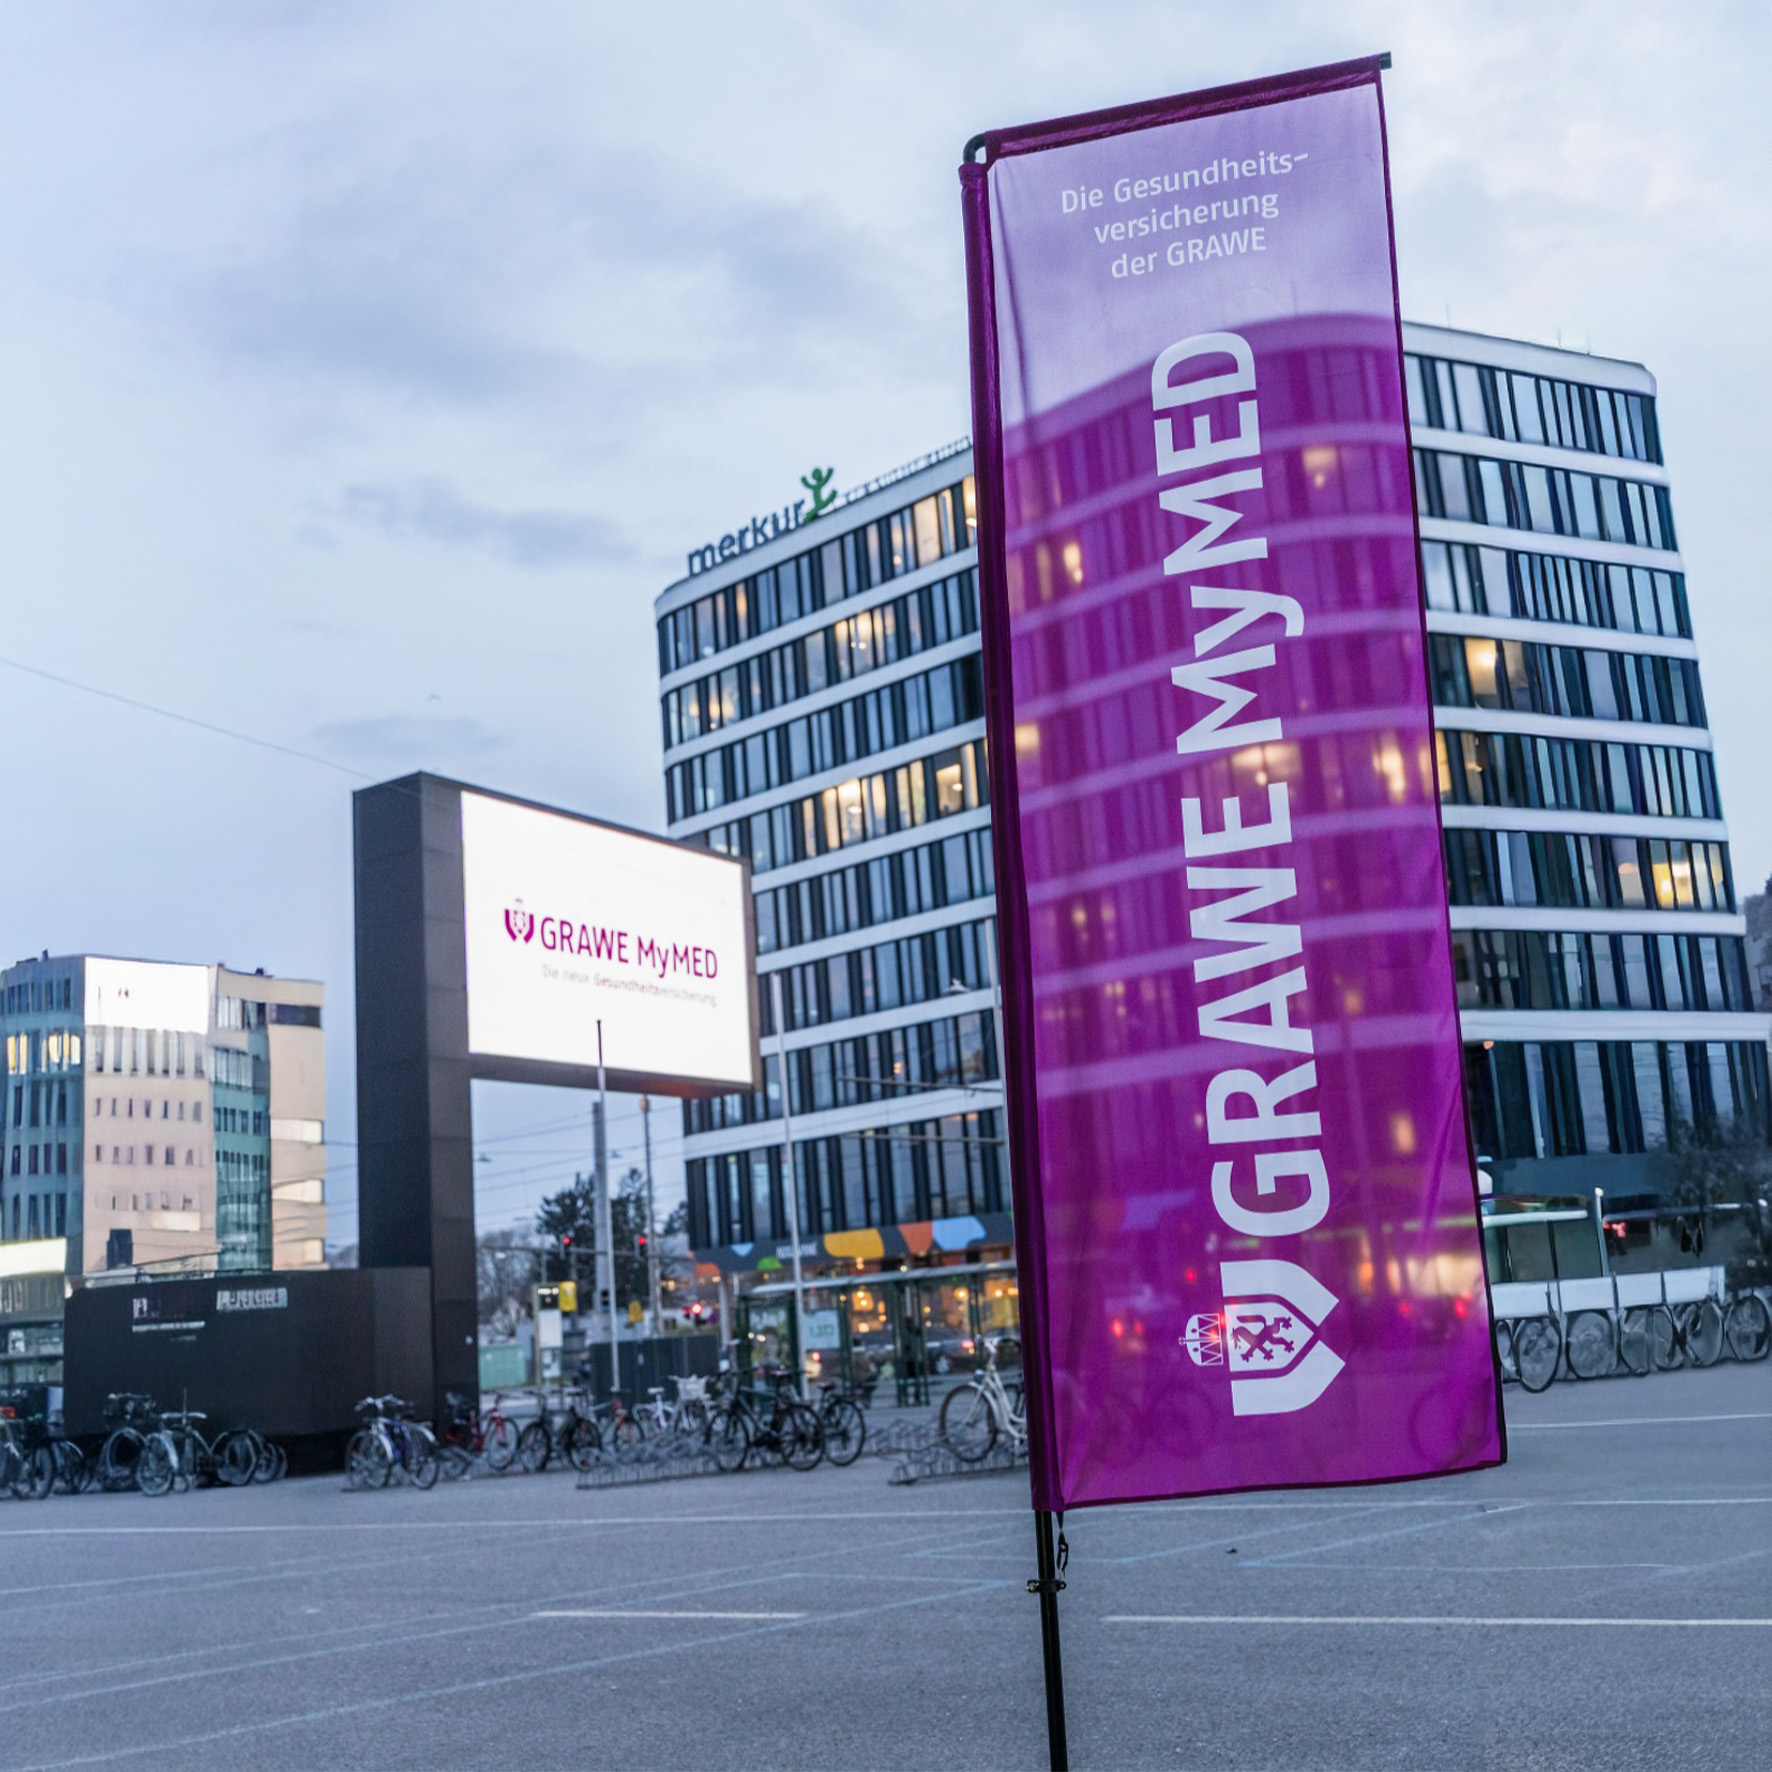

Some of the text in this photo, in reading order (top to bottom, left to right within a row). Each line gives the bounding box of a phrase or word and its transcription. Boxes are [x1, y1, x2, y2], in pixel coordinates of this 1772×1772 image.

[1061, 150, 1309, 214] Die Gesundheits-
[1094, 193, 1280, 244] versicherung
[1111, 227, 1267, 279] der GRAWE
[687, 499, 805, 577] merkur
[1151, 331, 1331, 1238] GRAWE MyMED
[540, 916, 718, 979] GRAWE MyMED
